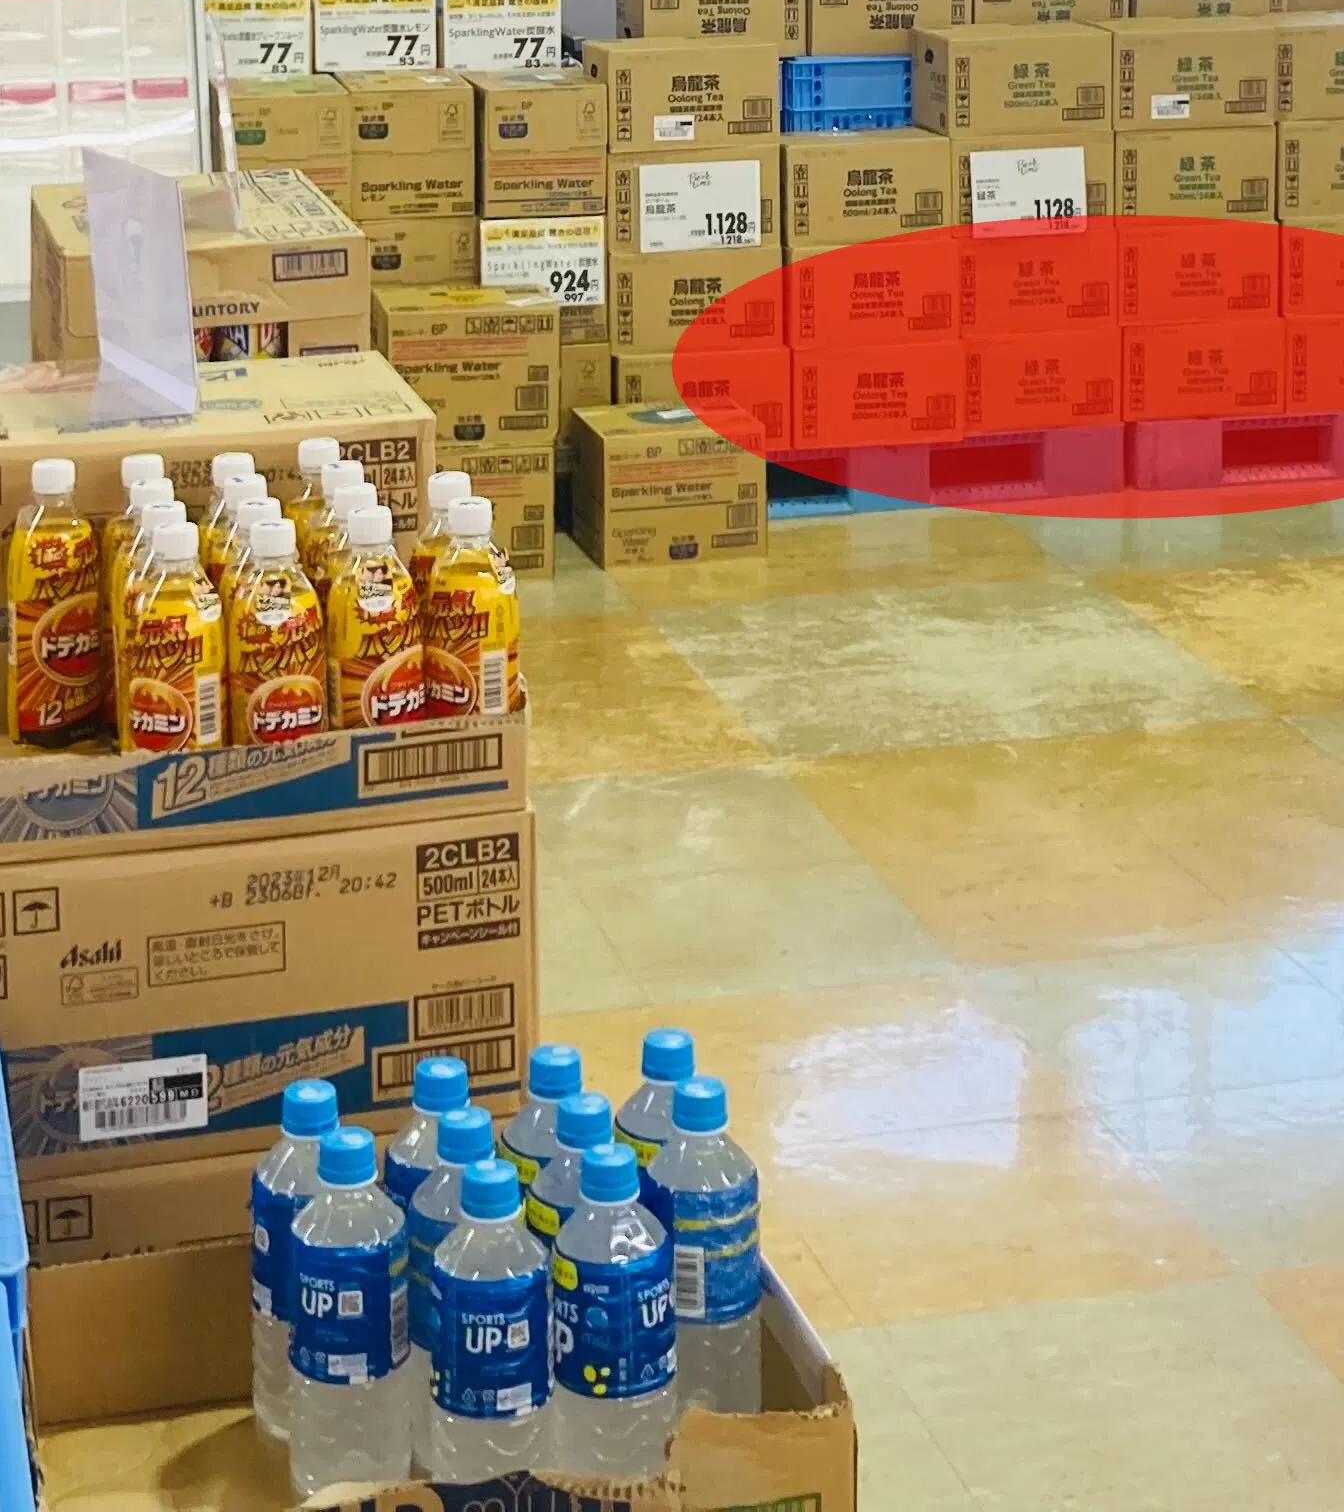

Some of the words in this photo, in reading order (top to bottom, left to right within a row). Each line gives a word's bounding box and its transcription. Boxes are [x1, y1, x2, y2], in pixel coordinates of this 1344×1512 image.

[671, 74, 720, 92] 烏龍茶
[1202, 74, 1219, 83] Tea
[667, 93, 703, 103] Oolong
[706, 92, 724, 101] Tea
[1179, 156, 1216, 172] 緑茶
[361, 182, 422, 193] Sparkling
[426, 179, 464, 189] Water
[494, 179, 554, 191] Sparkling
[557, 178, 594, 188] Water
[846, 168, 894, 186] 烏龍茶
[1204, 173, 1221, 182] Tea
[361, 194, 386, 202] レモン
[843, 188, 879, 198] Oolong
[881, 187, 897, 196] Tea
[673, 277, 723, 296] 烏龍茶
[395, 363, 458, 375] Sparkling
[461, 361, 503, 373] Water
[383, 466, 415, 485] 24本入
[611, 484, 672, 498] Sparkling
[675, 481, 713, 493] Water
[423, 839, 512, 870] 2CLB2
[340, 872, 397, 895] 20:42
[422, 874, 475, 896] 500ml
[480, 868, 519, 890] 24本入
[418, 898, 521, 926] PETボトル
[421, 922, 519, 947] キャンペーンシール付
[60, 939, 122, 969] Asahi
[299, 1272, 336, 1292] SPORTS
[301, 1287, 333, 1318] UP
[641, 1293, 669, 1329] UP
[461, 1312, 506, 1326] SPORTS
[466, 1326, 503, 1354] UP
